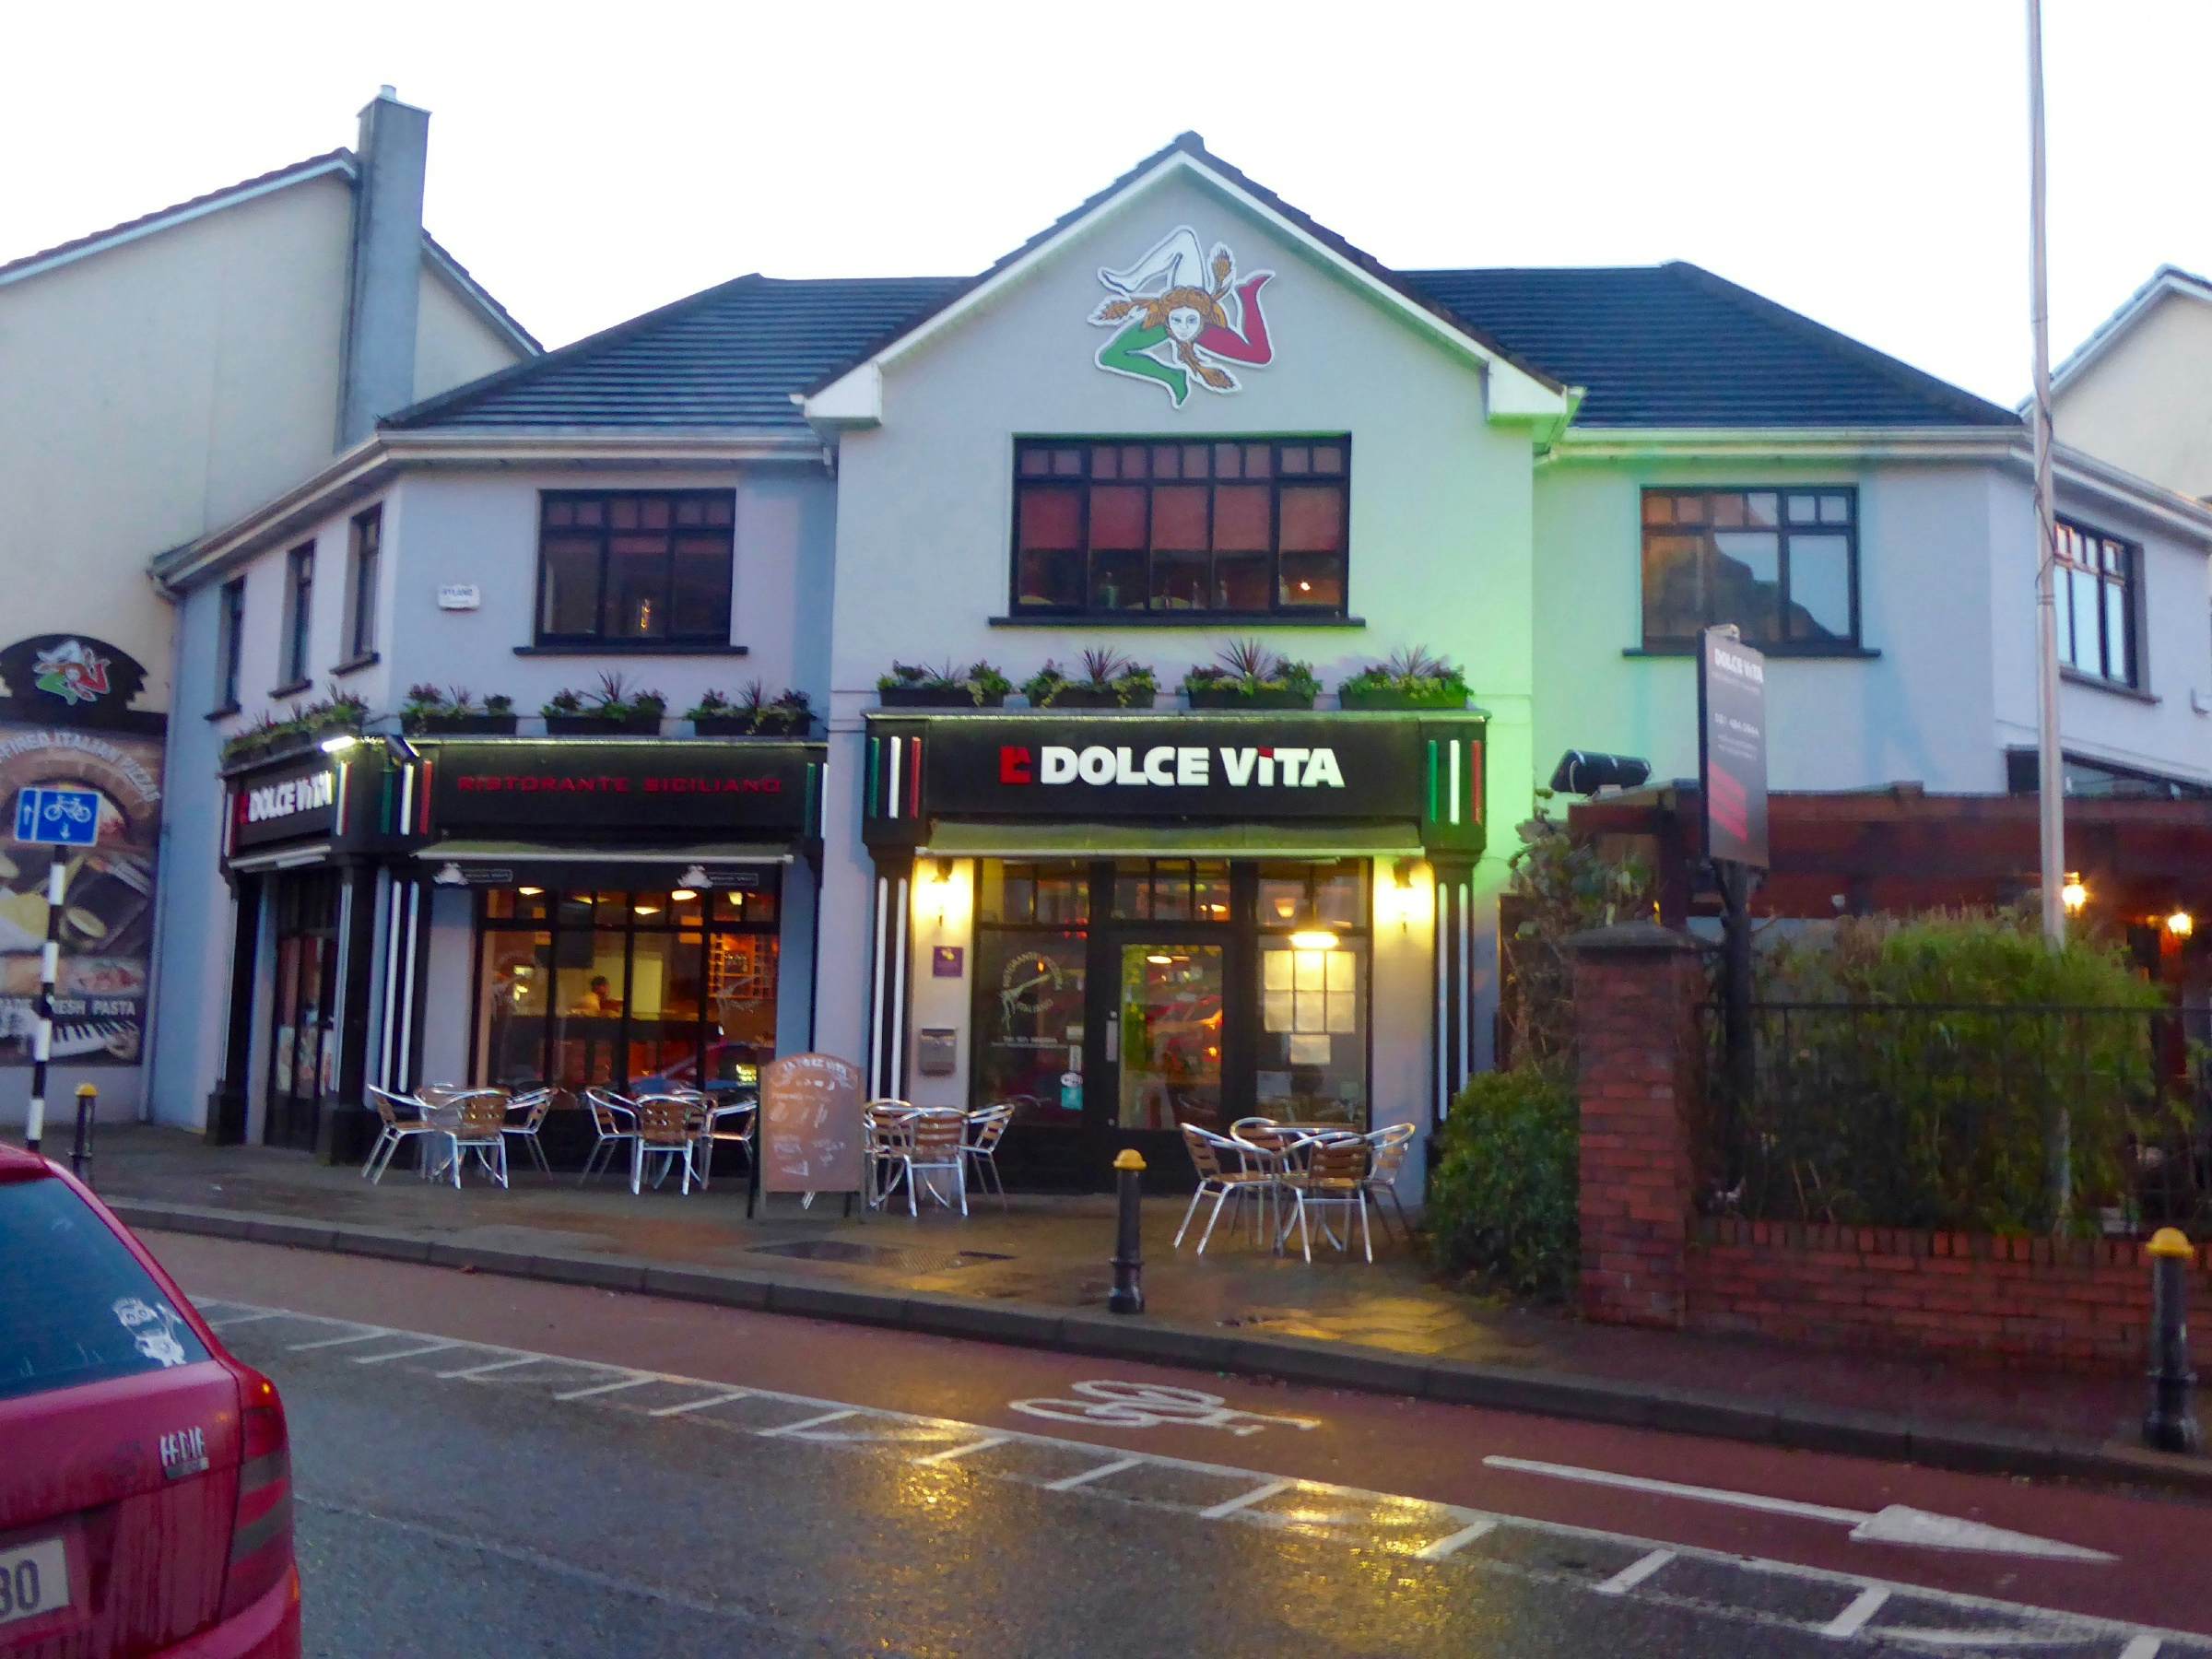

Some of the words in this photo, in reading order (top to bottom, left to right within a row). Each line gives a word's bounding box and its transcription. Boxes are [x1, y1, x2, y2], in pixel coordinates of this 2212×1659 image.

[1041, 746, 1209, 787] DOLCE
[457, 776, 630, 794] RISTORANTE
[641, 777, 782, 794] SICILIANO
[93, 1000, 135, 1016] PASTA
